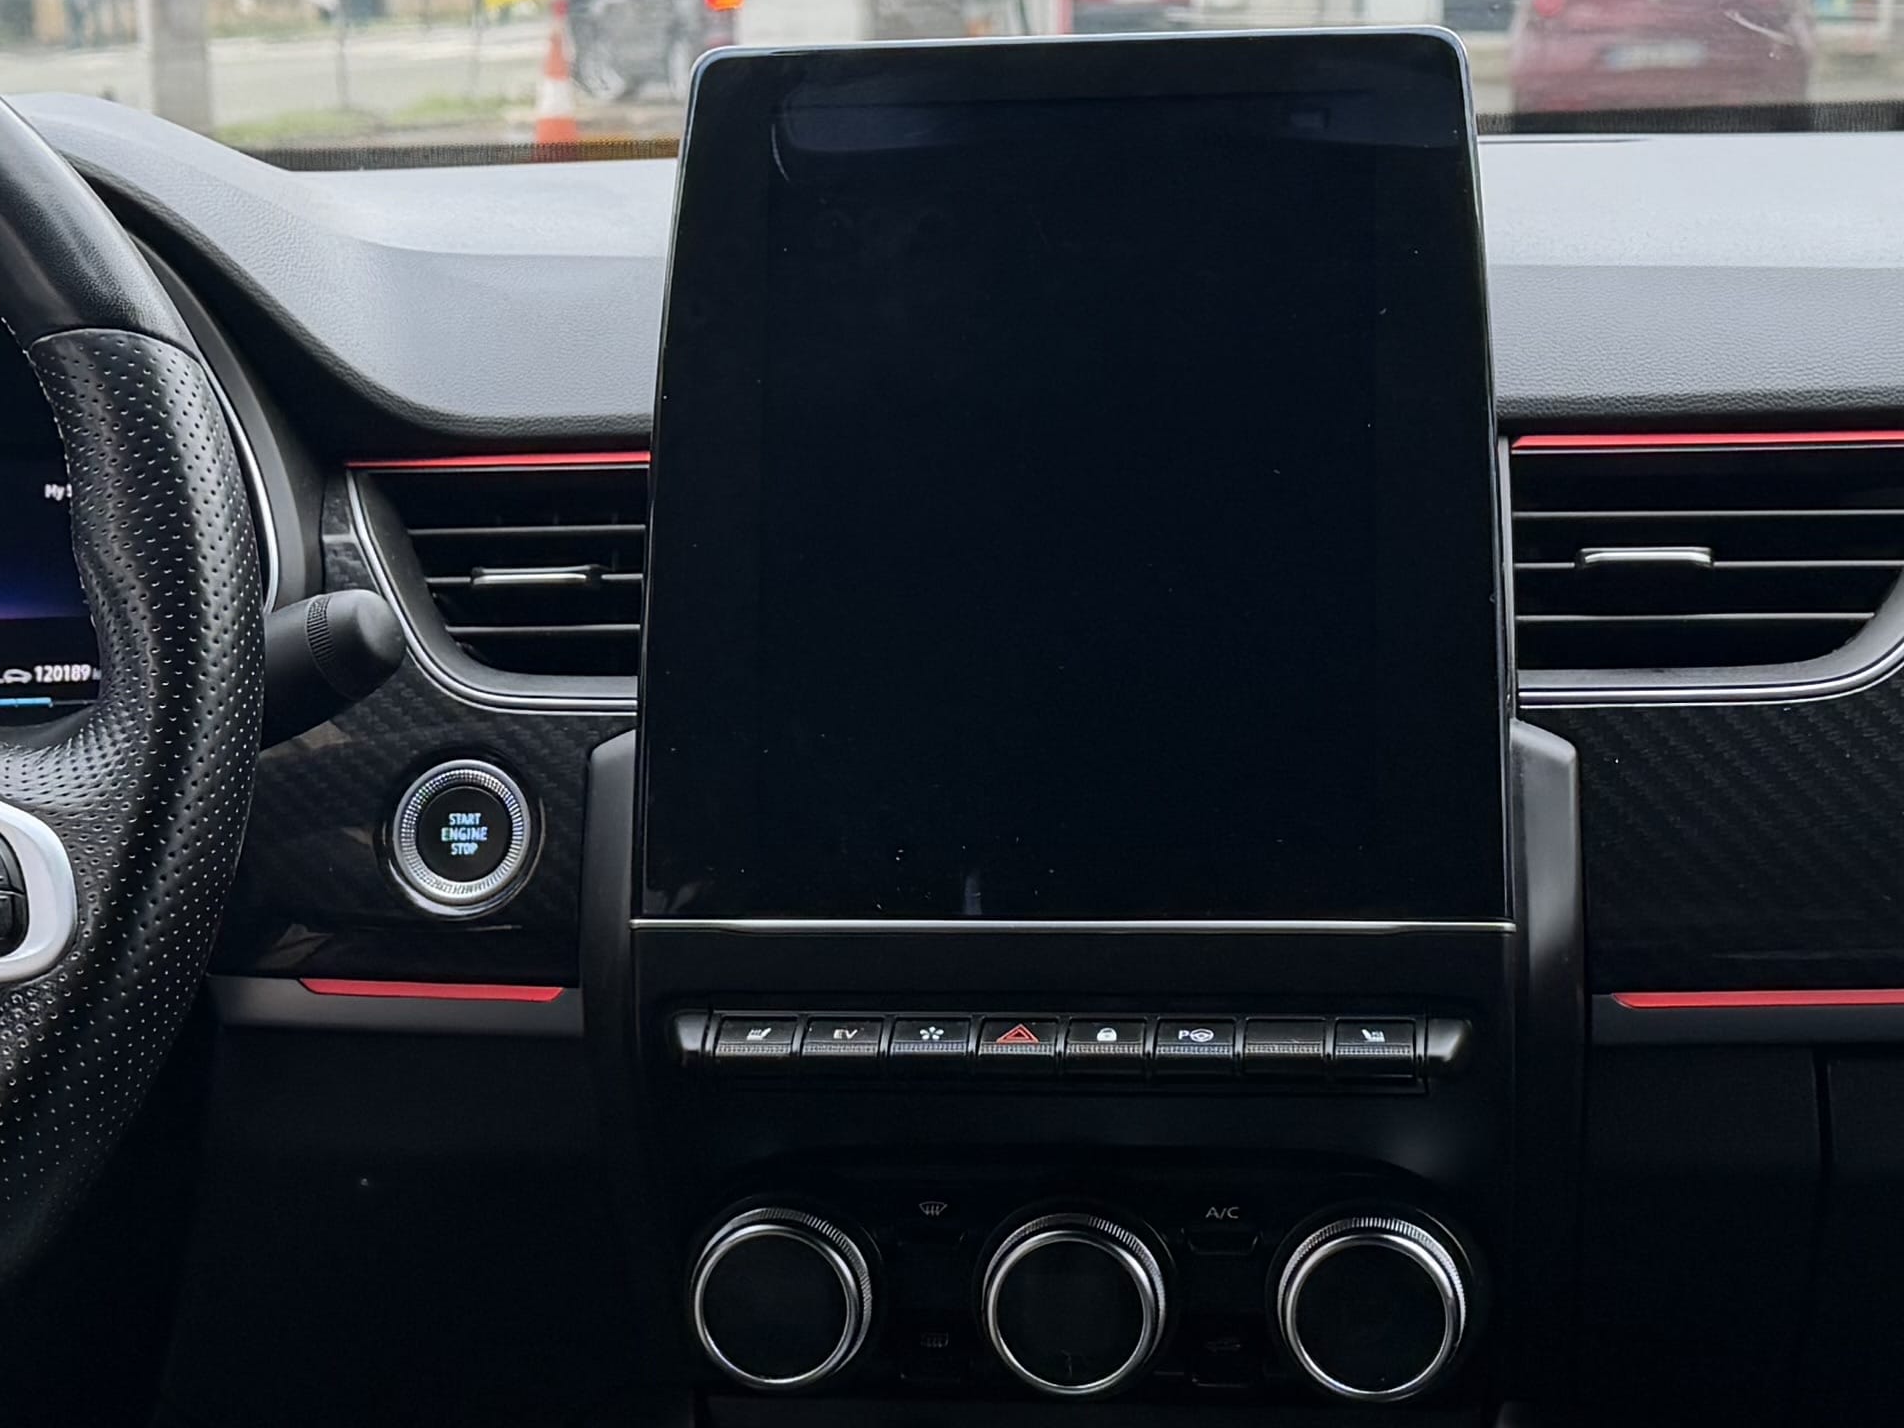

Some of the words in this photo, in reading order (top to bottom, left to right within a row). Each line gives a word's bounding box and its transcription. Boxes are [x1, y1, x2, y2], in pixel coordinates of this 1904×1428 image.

[34, 663, 92, 683] 120189
[448, 812, 482, 827] START
[441, 826, 488, 842] ENGINE
[450, 841, 479, 857] STOP
[832, 1027, 858, 1039] EV
[1204, 1205, 1241, 1221] A/C
